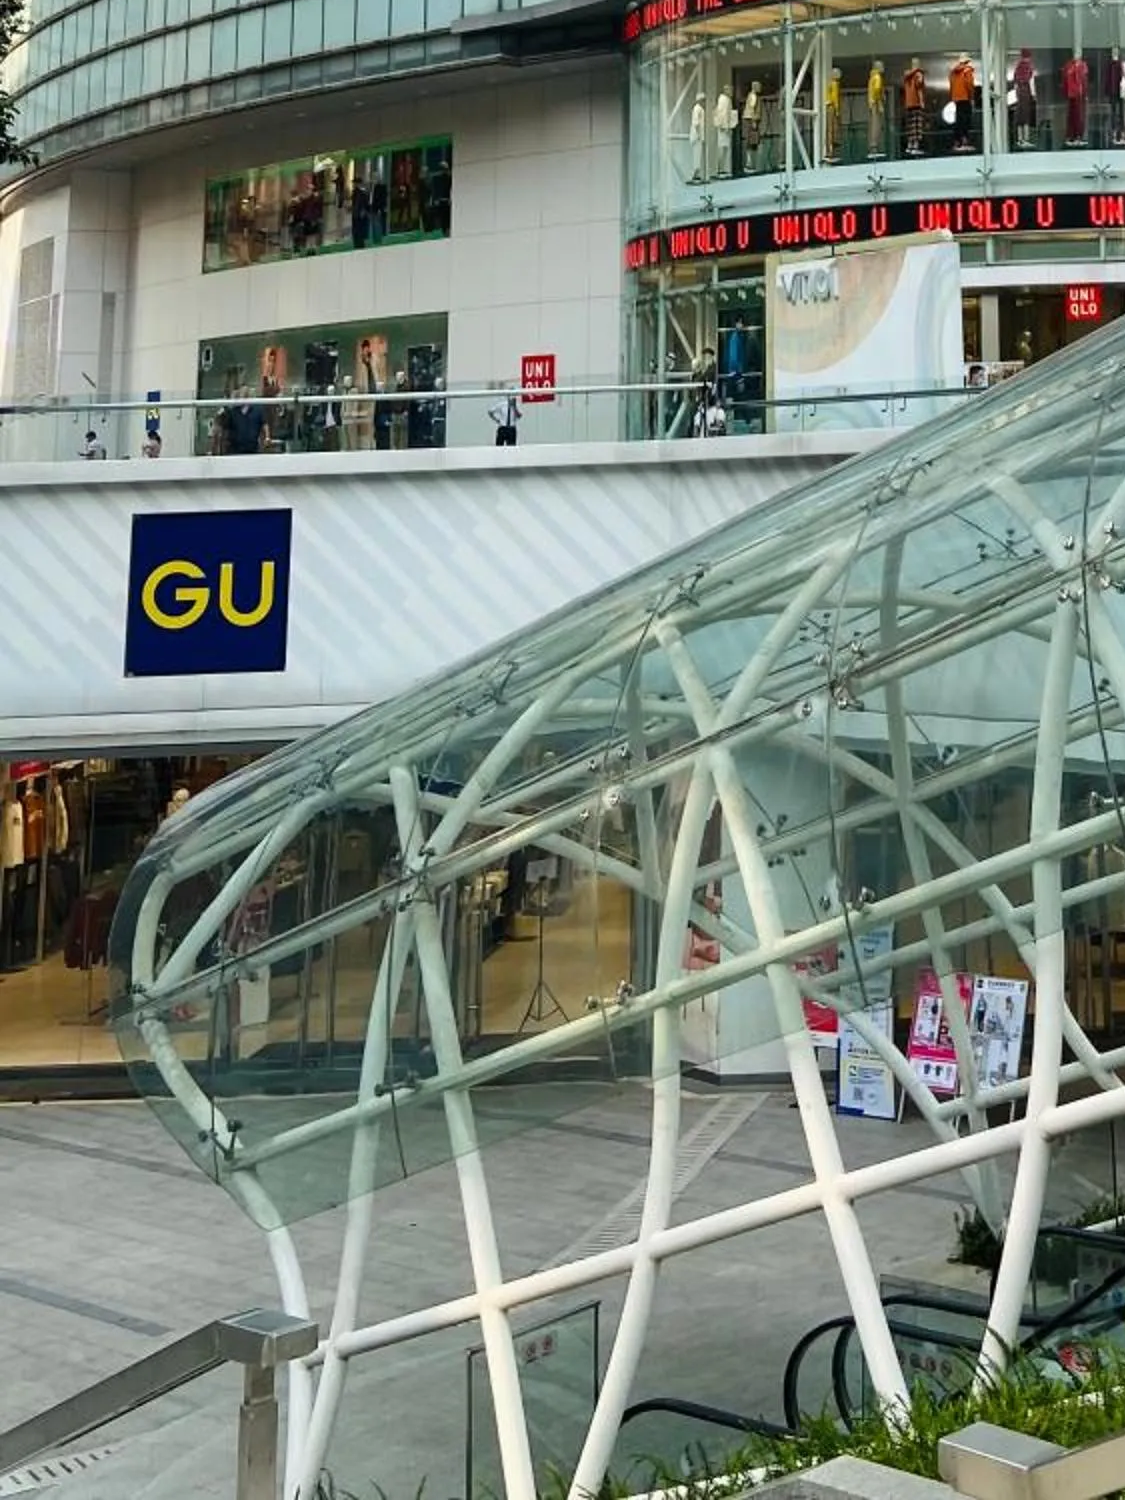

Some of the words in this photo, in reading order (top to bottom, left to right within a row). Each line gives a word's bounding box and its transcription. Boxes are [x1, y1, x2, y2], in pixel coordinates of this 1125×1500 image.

[670, 222, 727, 259] UNIQLO
[737, 220, 750, 249] U
[772, 210, 857, 246] UNIQLO
[871, 202, 888, 237] U
[918, 198, 1019, 233] UNIQLO
[1036, 197, 1054, 228] U
[1069, 287, 1096, 302] UNI
[1069, 301, 1098, 317] QLO
[525, 360, 549, 379] UNI
[141, 558, 276, 630] GU
